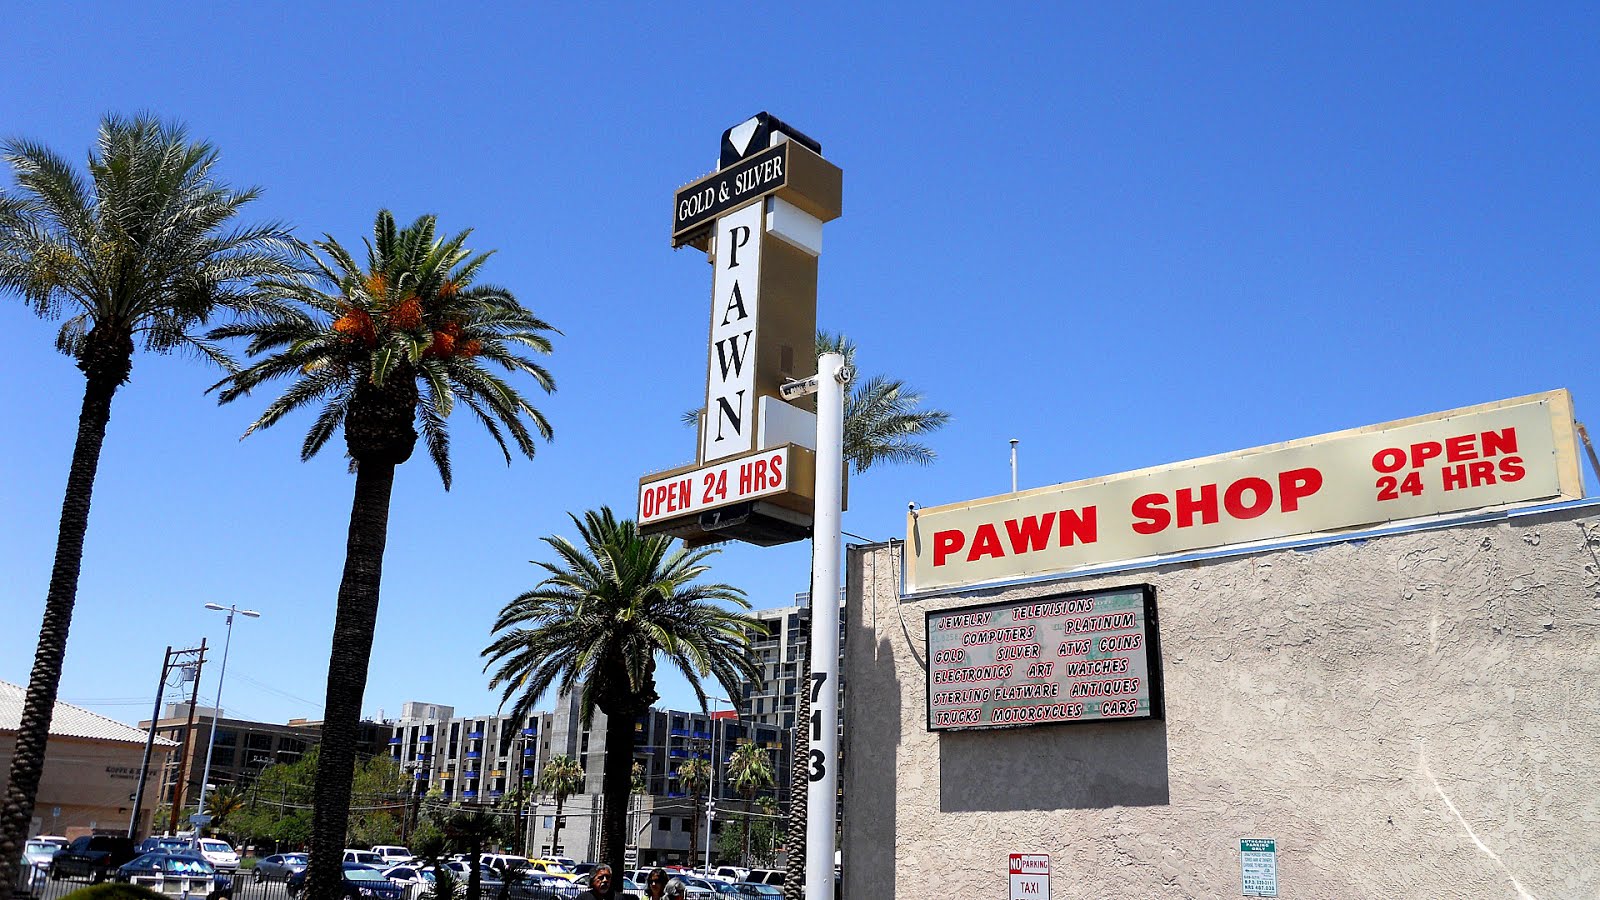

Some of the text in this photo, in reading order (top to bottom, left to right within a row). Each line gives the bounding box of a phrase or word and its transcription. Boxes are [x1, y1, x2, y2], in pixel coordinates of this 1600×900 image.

[679, 156, 783, 221] GOLD & SILVER
[714, 225, 753, 443] PAWN
[1371, 427, 1518, 474] OPEN
[643, 455, 782, 518] OPEN 24 HRS
[1375, 456, 1526, 502] 24 HRS
[932, 467, 1323, 567] PAWN SHOP
[938, 598, 1093, 629] JEWELRY TELEVISIONS
[963, 626, 1035, 645] COMPUTERS
[1065, 613, 1135, 633] PLATINUM
[935, 635, 1142, 663] GOLD SILVER ATVS COINS
[935, 659, 1128, 684] ELECTRONICS ART WATCHES
[934, 679, 1139, 705] STERLING FLATWARE ANTIQUES
[809, 672, 828, 783] 713
[936, 700, 1136, 725] TRUCKS MOTORCYCLES CARS
[1010, 858, 1048, 870] NO PARKING
[1020, 881, 1040, 894] TAXI
